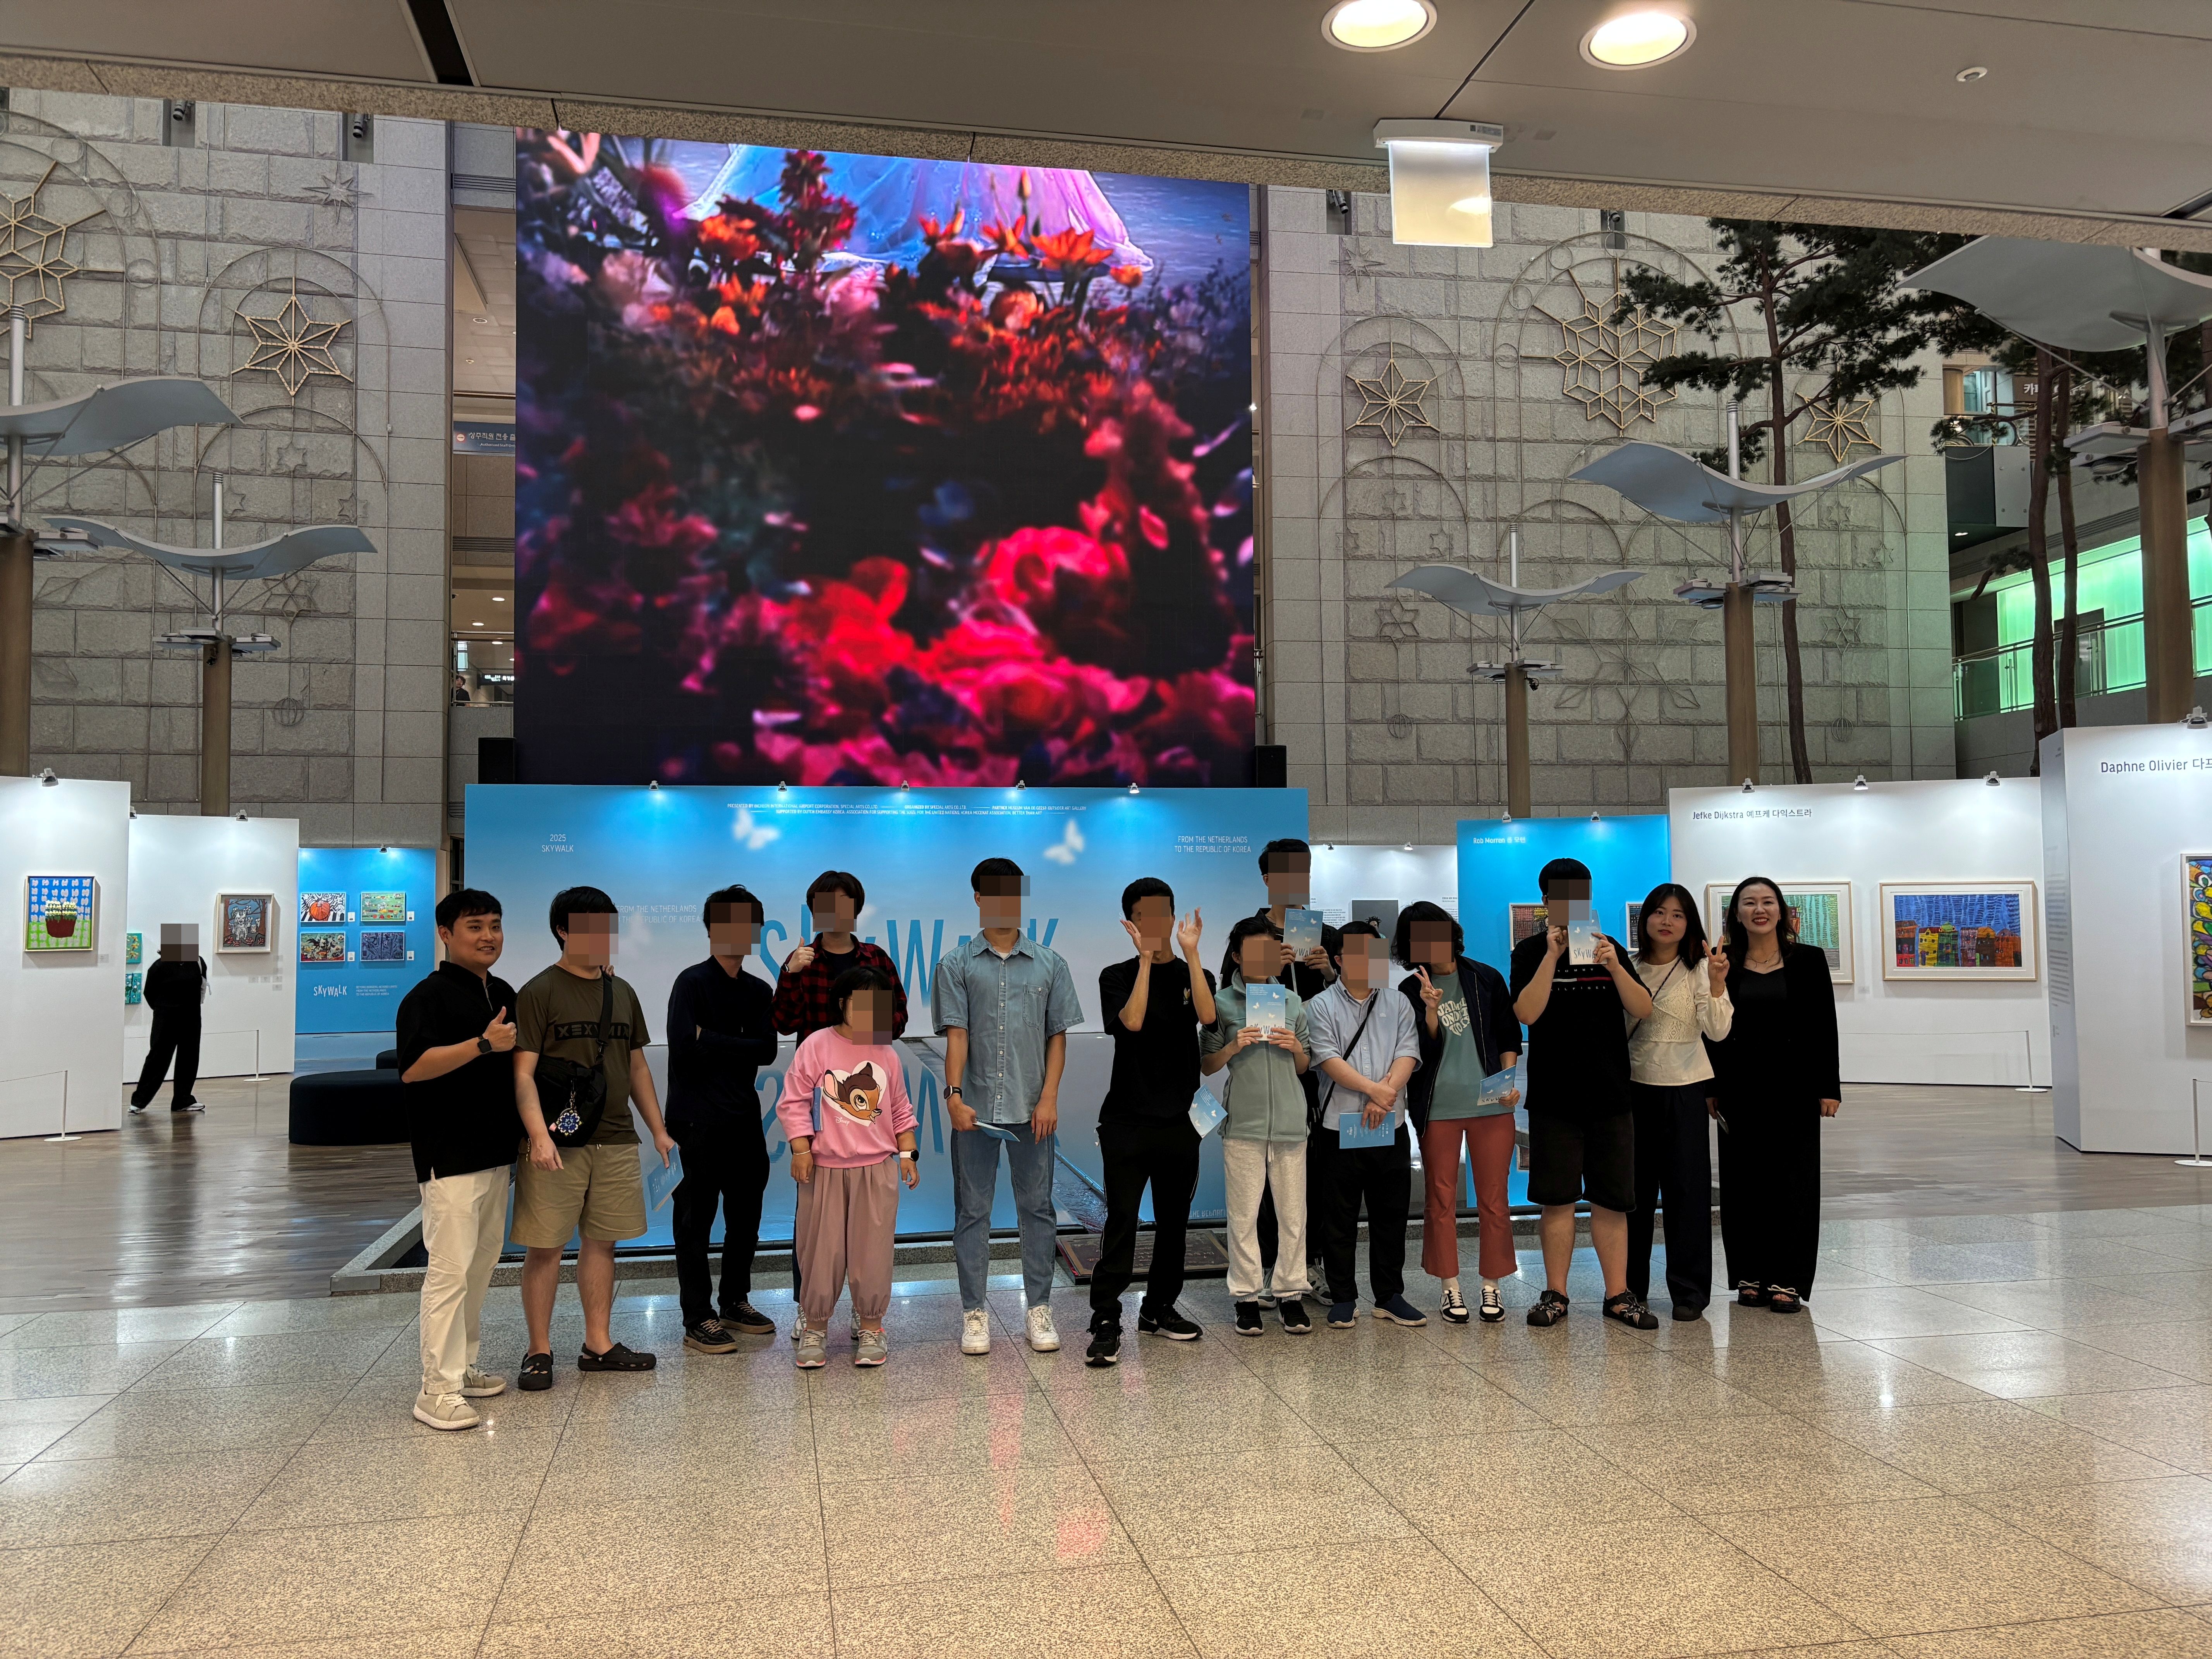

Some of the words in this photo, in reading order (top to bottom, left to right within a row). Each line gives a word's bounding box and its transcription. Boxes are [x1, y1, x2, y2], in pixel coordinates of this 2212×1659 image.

[2024, 383, 2038, 395] 카
[2101, 761, 2145, 774] Daphne
[2149, 759, 2188, 771] Olivier
[1714, 811, 1743, 820] Dijkstra
[1747, 810, 1770, 818] 예프케
[1772, 808, 1812, 817] 다익스트라
[314, 984, 347, 997] SKYWALK
